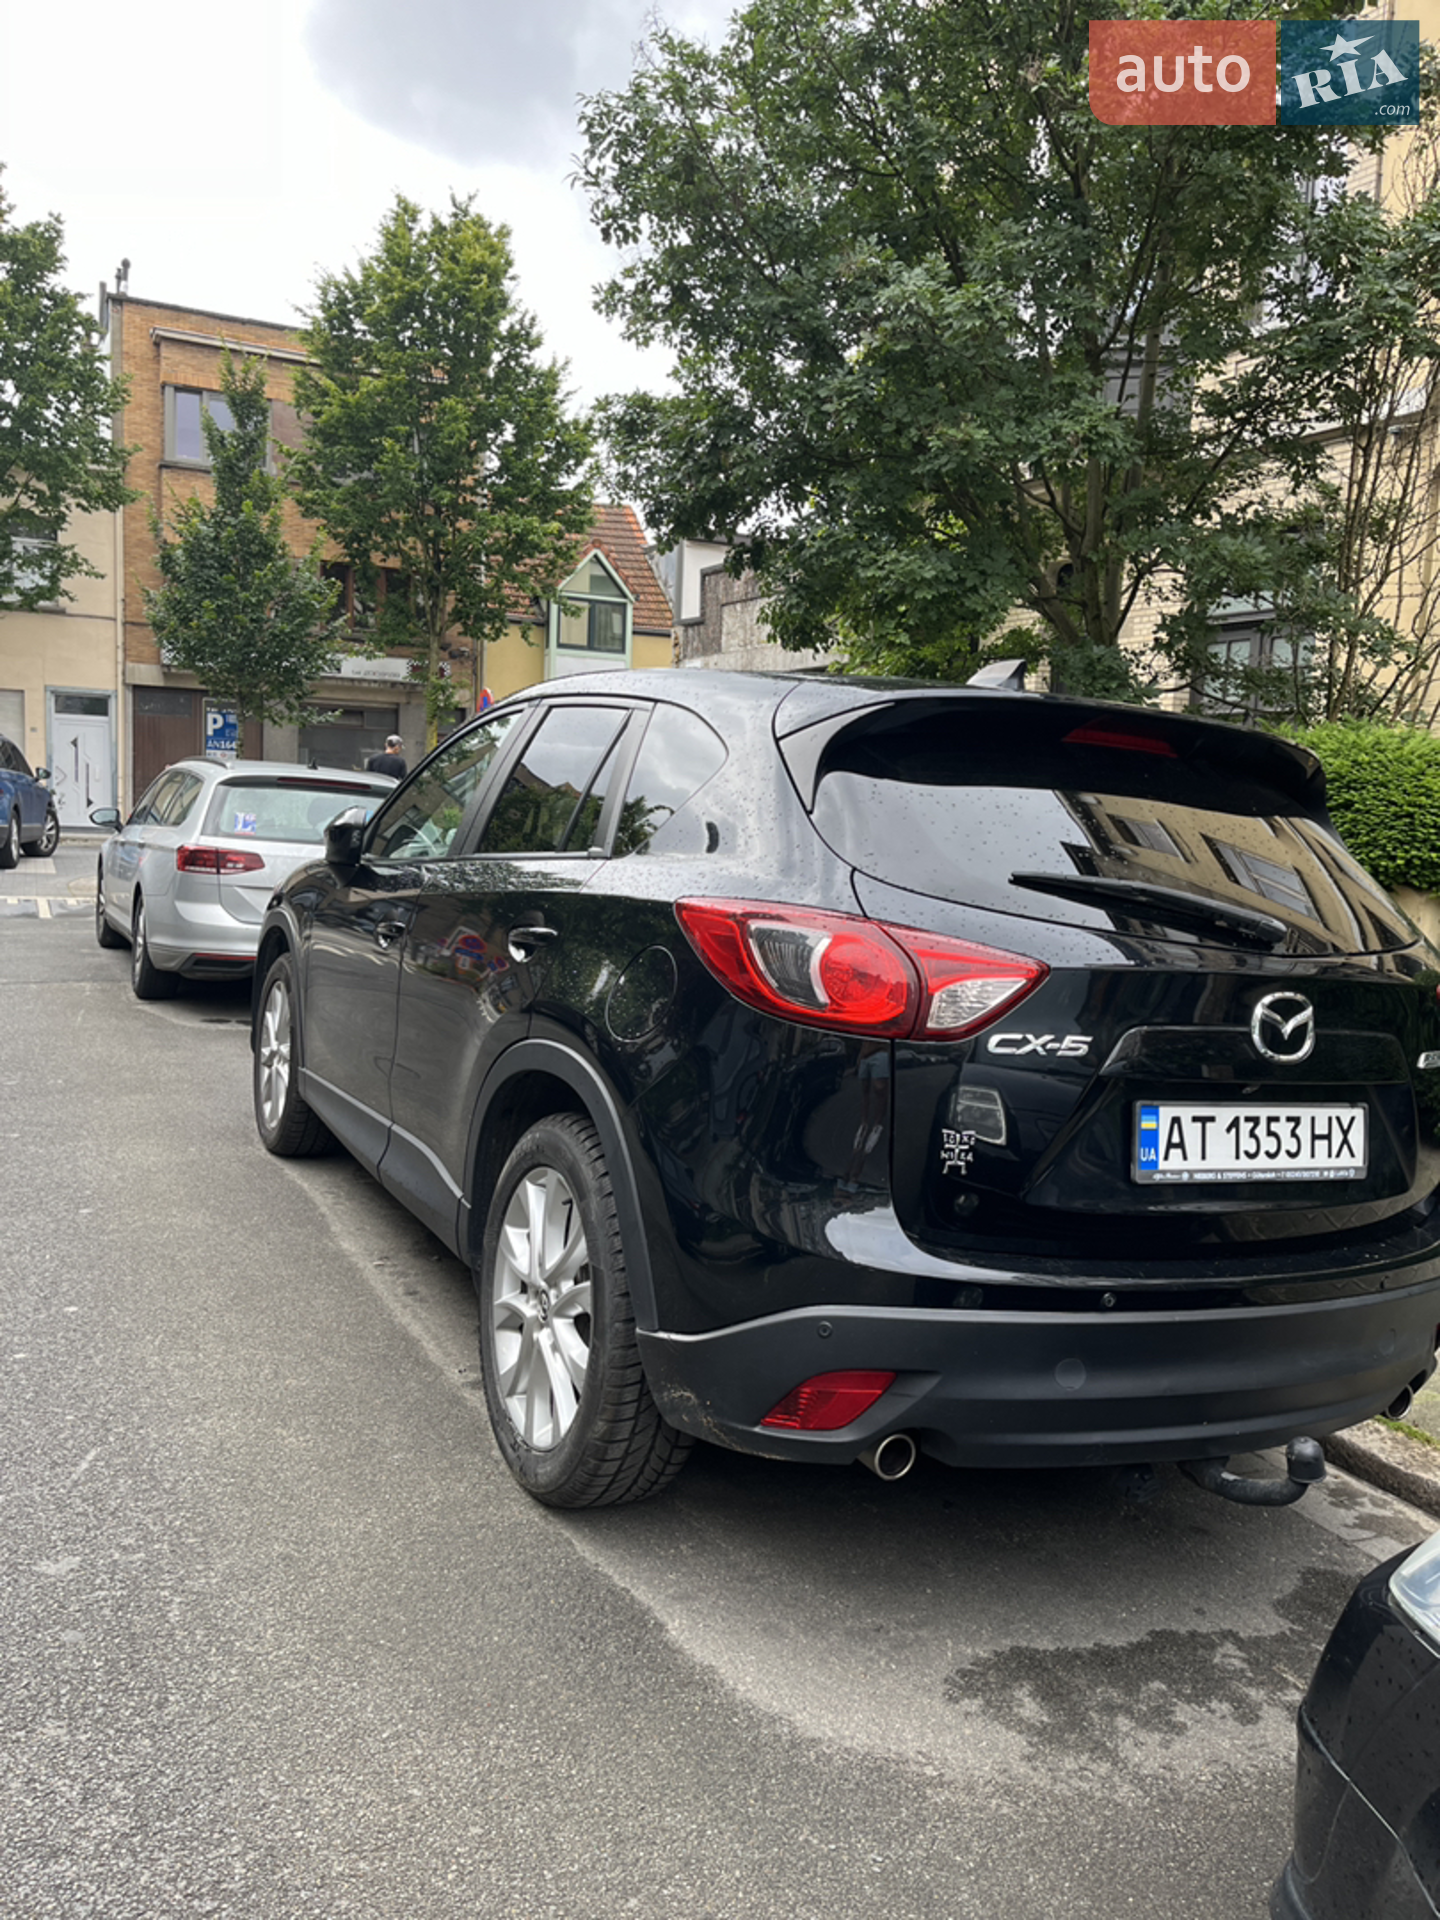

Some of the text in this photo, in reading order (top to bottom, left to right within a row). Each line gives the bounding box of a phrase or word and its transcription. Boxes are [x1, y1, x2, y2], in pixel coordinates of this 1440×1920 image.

[207, 713, 224, 736] P
[987, 1033, 1094, 1057] CX-5
[1163, 1115, 1356, 1162] AT 1353 HX
[1140, 1147, 1157, 1161] UA
